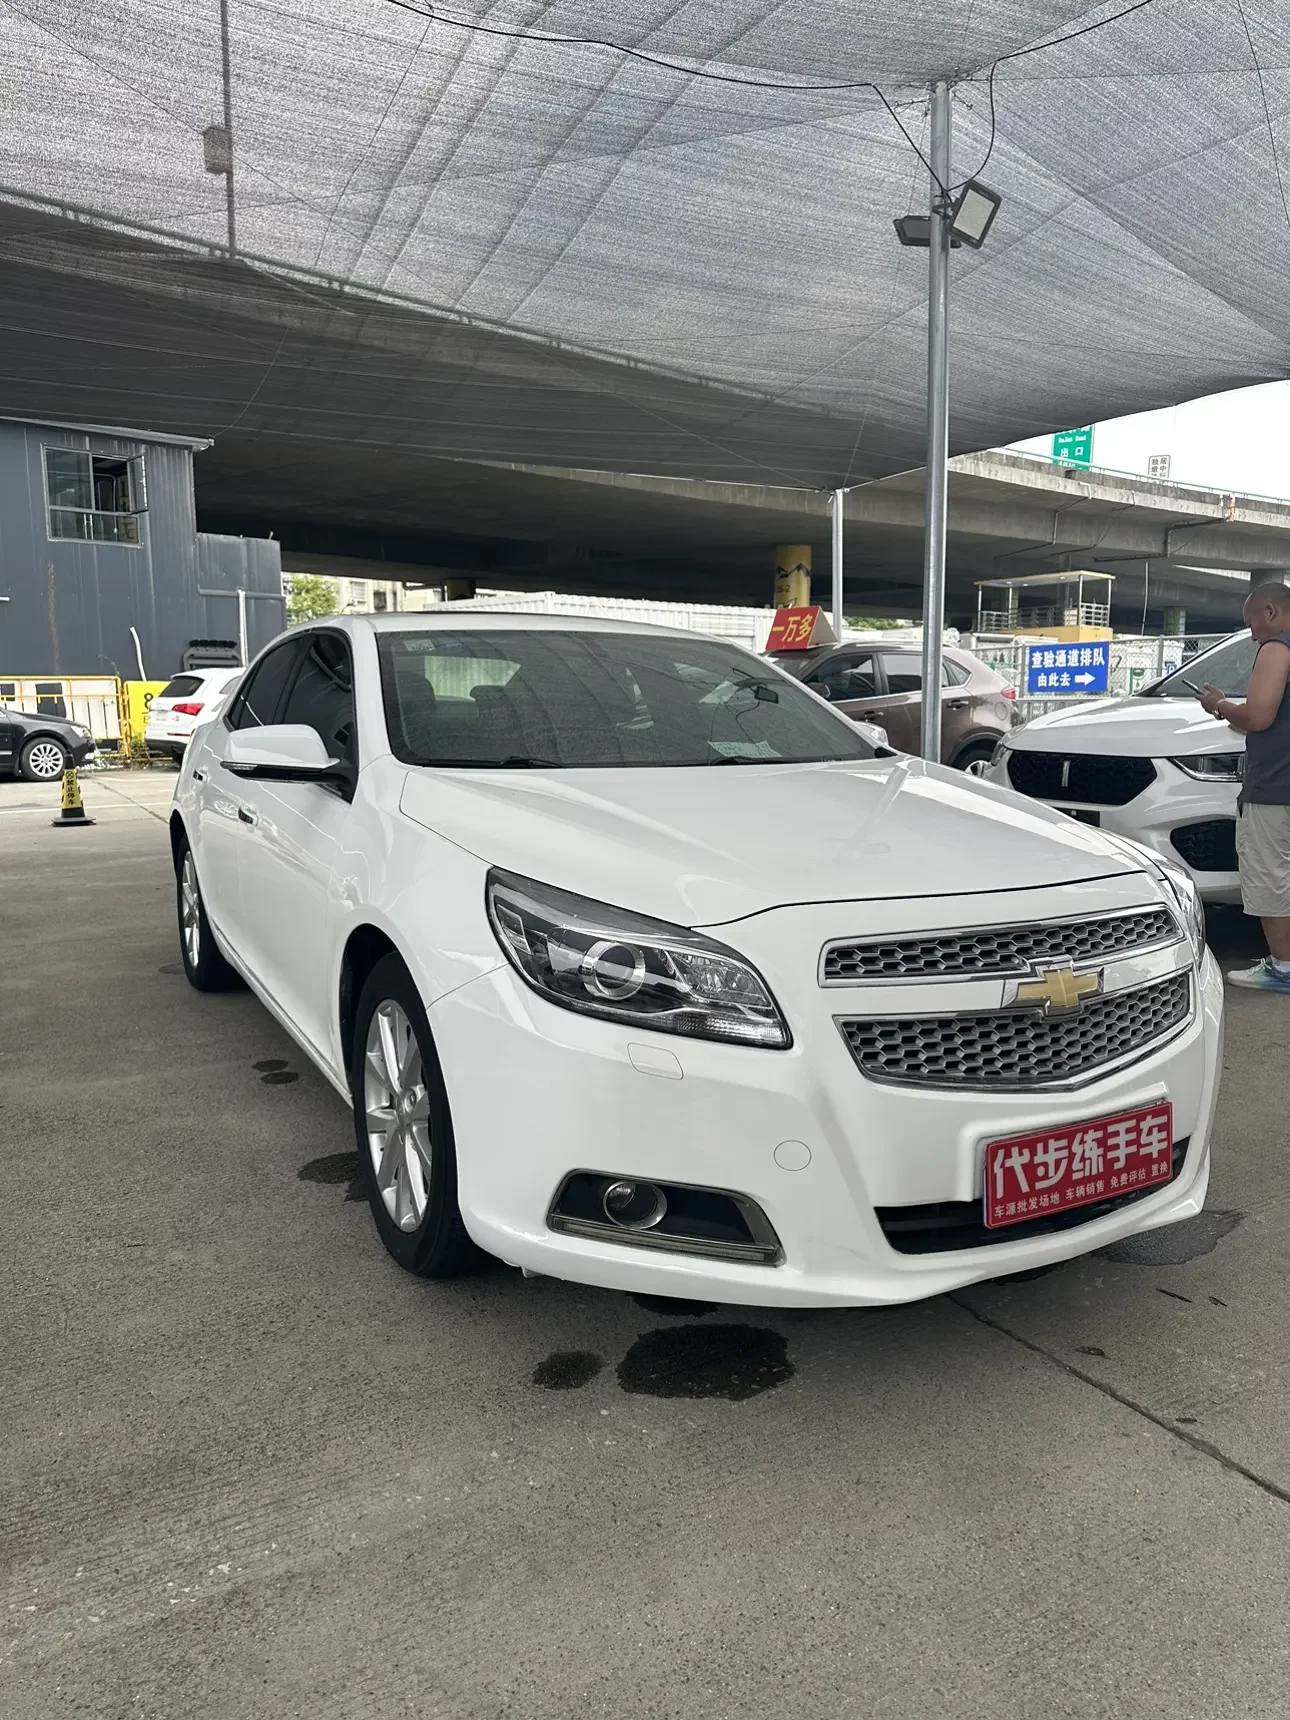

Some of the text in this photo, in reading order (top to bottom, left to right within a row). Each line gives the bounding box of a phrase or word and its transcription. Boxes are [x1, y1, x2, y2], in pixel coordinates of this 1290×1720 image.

[1060, 447, 1083, 457] 出口
[772, 613, 813, 642] 一万多
[1031, 647, 1105, 669] 查验通道排队
[1037, 672, 1071, 687] 由此去
[66, 779, 76, 805] 禁止停车
[993, 1114, 1168, 1199] 代步练手车
[994, 1161, 1168, 1218] 车源批发场地 车辆销售 免费评估 置换
